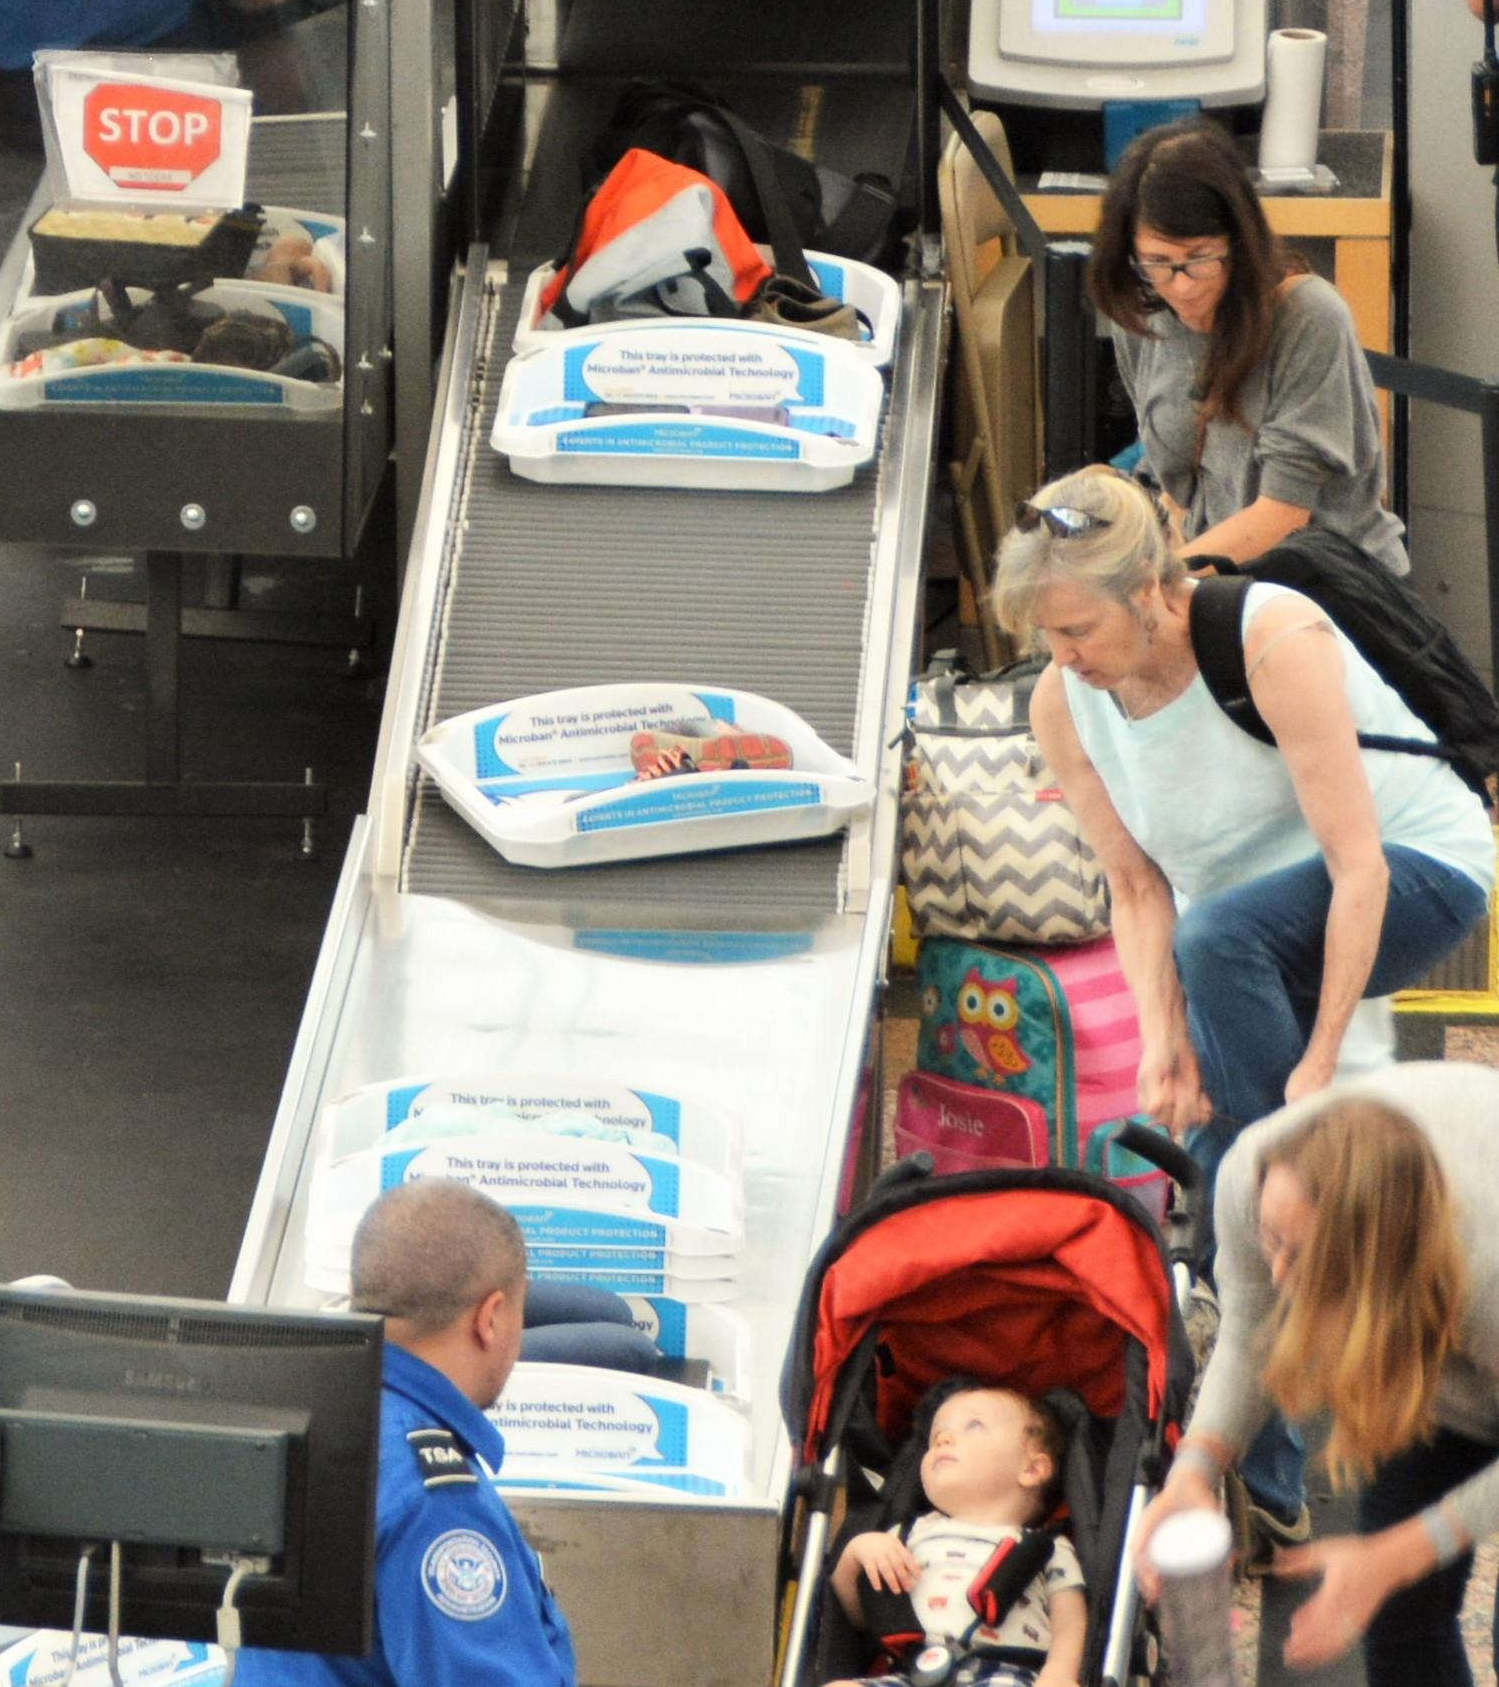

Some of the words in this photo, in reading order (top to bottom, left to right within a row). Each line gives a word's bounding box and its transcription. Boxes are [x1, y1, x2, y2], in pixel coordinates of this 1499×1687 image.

[98, 108, 209, 146] STOP
[620, 349, 644, 361] This
[646, 350, 668, 363] tray
[670, 349, 679, 361] is
[681, 350, 737, 364] protected
[739, 351, 763, 363] with
[648, 366, 726, 378] Antimicrobial
[729, 367, 795, 380] Technology
[531, 716, 556, 728] This
[558, 715, 580, 728] tray
[582, 712, 592, 723] is
[593, 705, 648, 722] protected
[650, 703, 674, 716] with
[559, 722, 638, 741] Antimicrobial
[450, 1093, 478, 1106] This
[506, 1094, 518, 1107] is
[519, 1095, 582, 1111] protected
[583, 1097, 611, 1109] with
[599, 1114, 647, 1128] nology
[937, 1103, 985, 1137] Josie
[446, 1157, 474, 1169] This
[476, 1158, 502, 1172] tray
[503, 1159, 515, 1171] is
[517, 1160, 581, 1175] protected
[582, 1162, 610, 1174] with
[478, 1174, 568, 1189] Antimicrobial
[572, 1177, 647, 1193] Technology
[506, 1401, 517, 1412] is
[519, 1401, 584, 1416] protected
[586, 1403, 615, 1414] with
[575, 1419, 653, 1434] Technology
[419, 1447, 464, 1464] TSA
